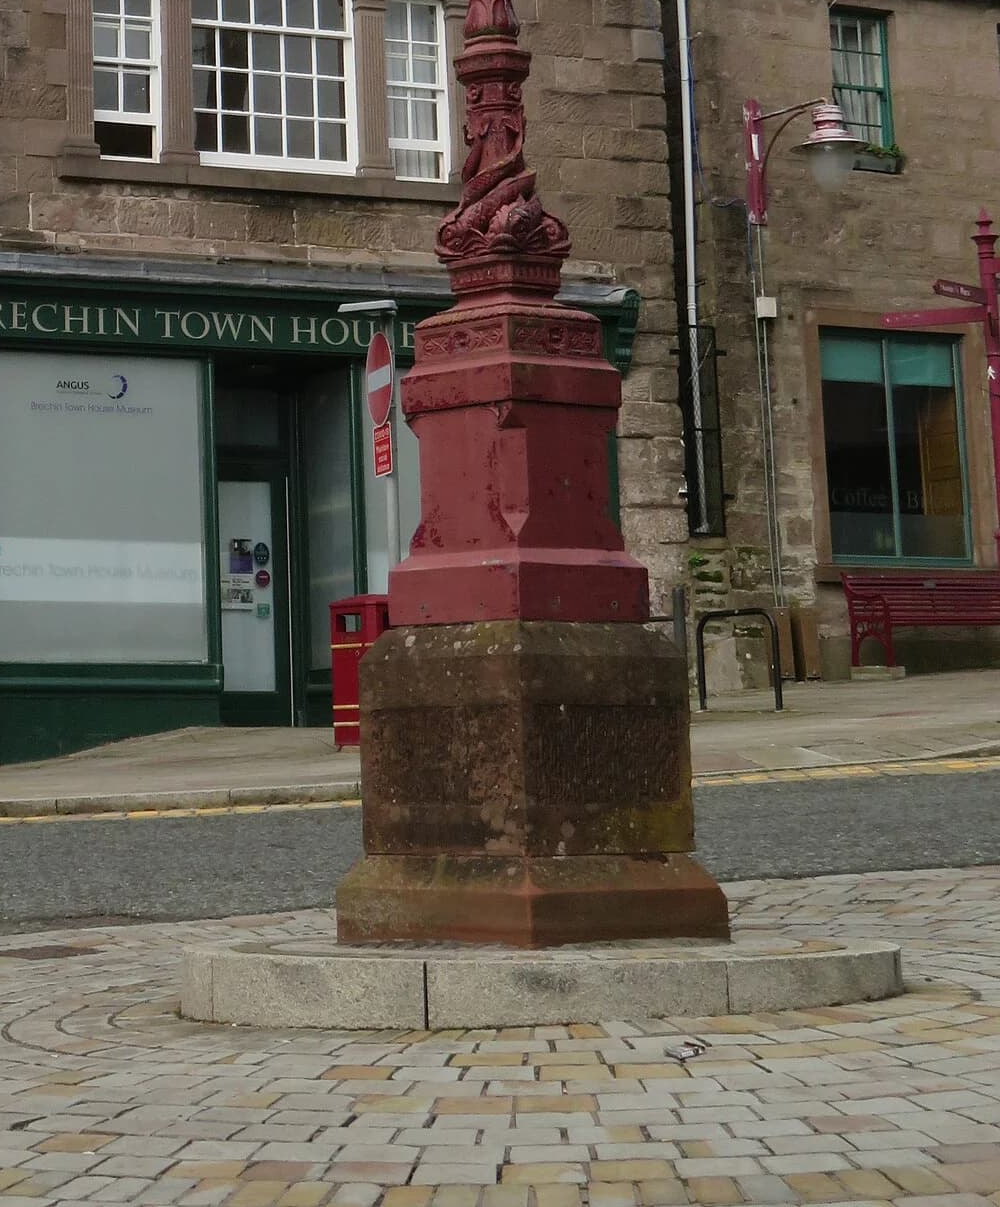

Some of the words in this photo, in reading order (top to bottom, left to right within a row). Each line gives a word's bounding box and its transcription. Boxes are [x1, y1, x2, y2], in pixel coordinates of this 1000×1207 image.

[154, 309, 276, 344] TOWN
[290, 315, 416, 348] HOUE
[55, 380, 90, 390] ANGUS
